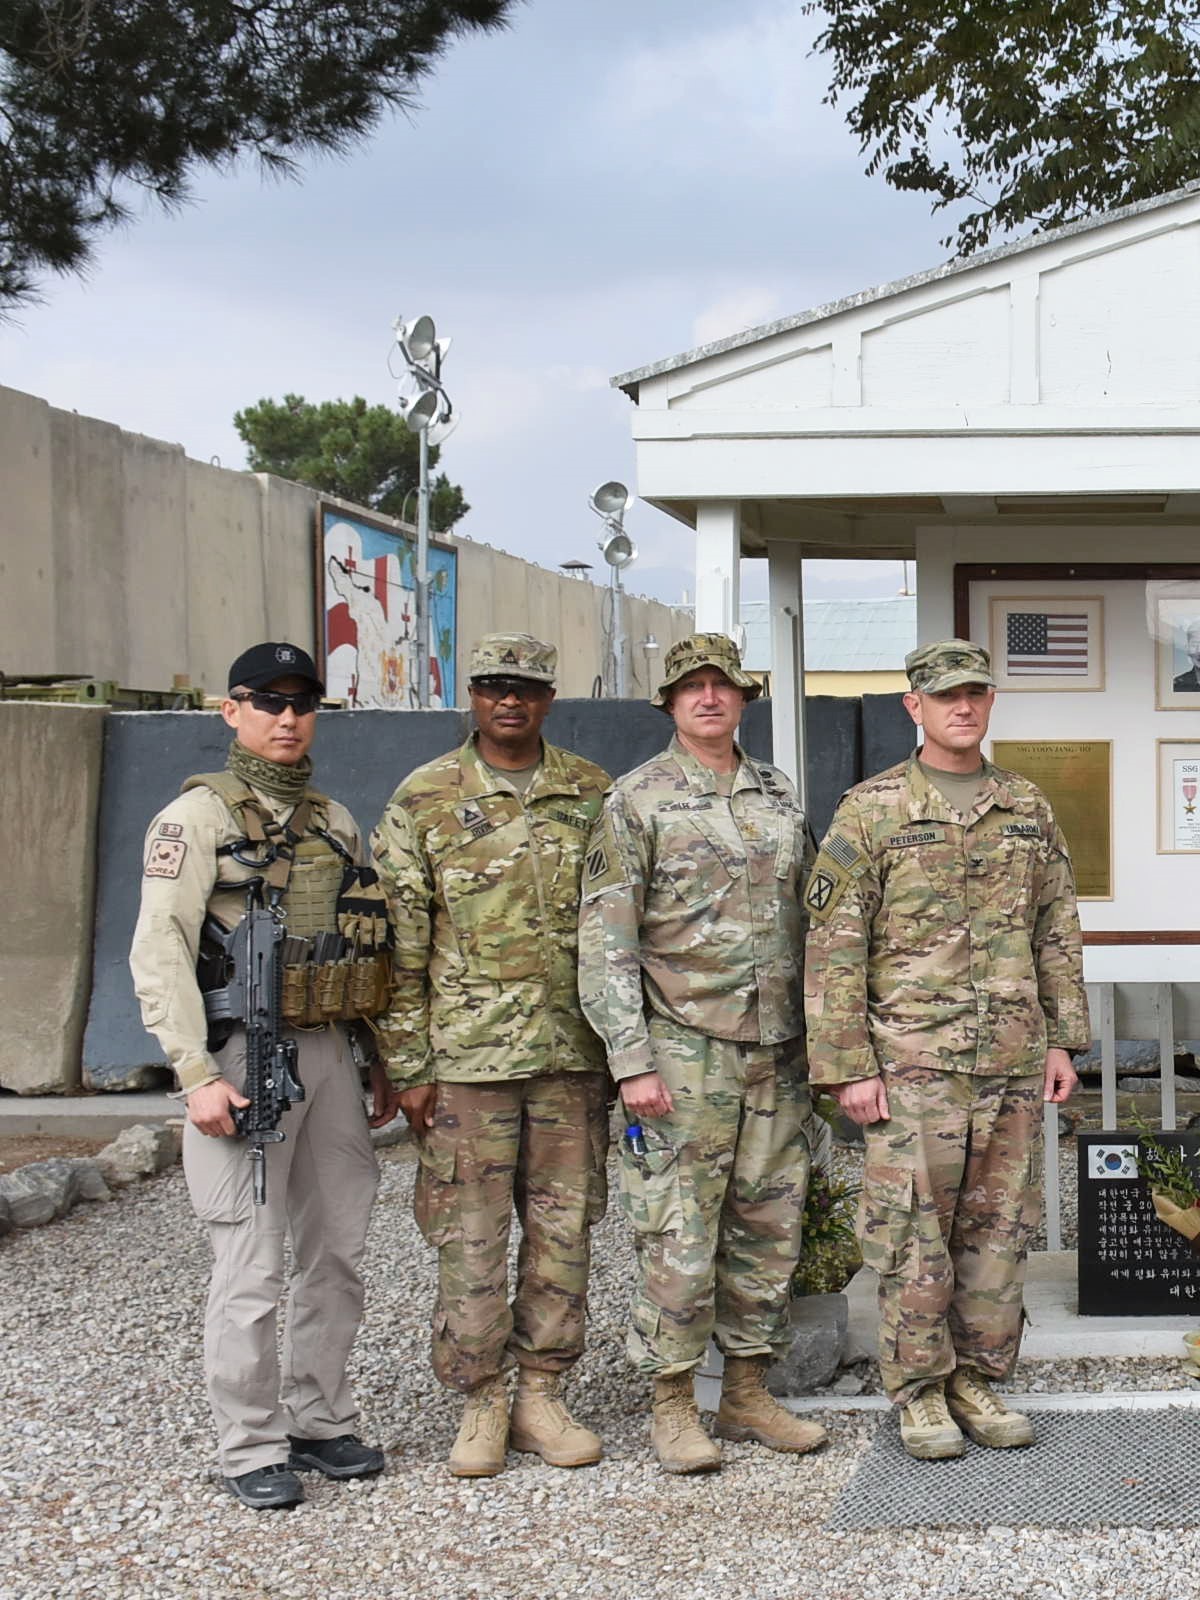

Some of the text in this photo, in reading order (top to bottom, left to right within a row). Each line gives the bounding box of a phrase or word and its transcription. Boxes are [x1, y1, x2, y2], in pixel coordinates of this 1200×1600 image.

[1182, 765, 1198, 773] SSG
[890, 831, 936, 846] PETERSON
[147, 866, 175, 876] KOREA
[1099, 1187, 1140, 1200] 대한민국
[1098, 1237, 1128, 1248] 숭고한
[1098, 1249, 1128, 1261] 영원히
[1110, 1268, 1130, 1279] 세계
[1135, 1268, 1156, 1280] 평화
[1160, 1268, 1191, 1279] 유지와
